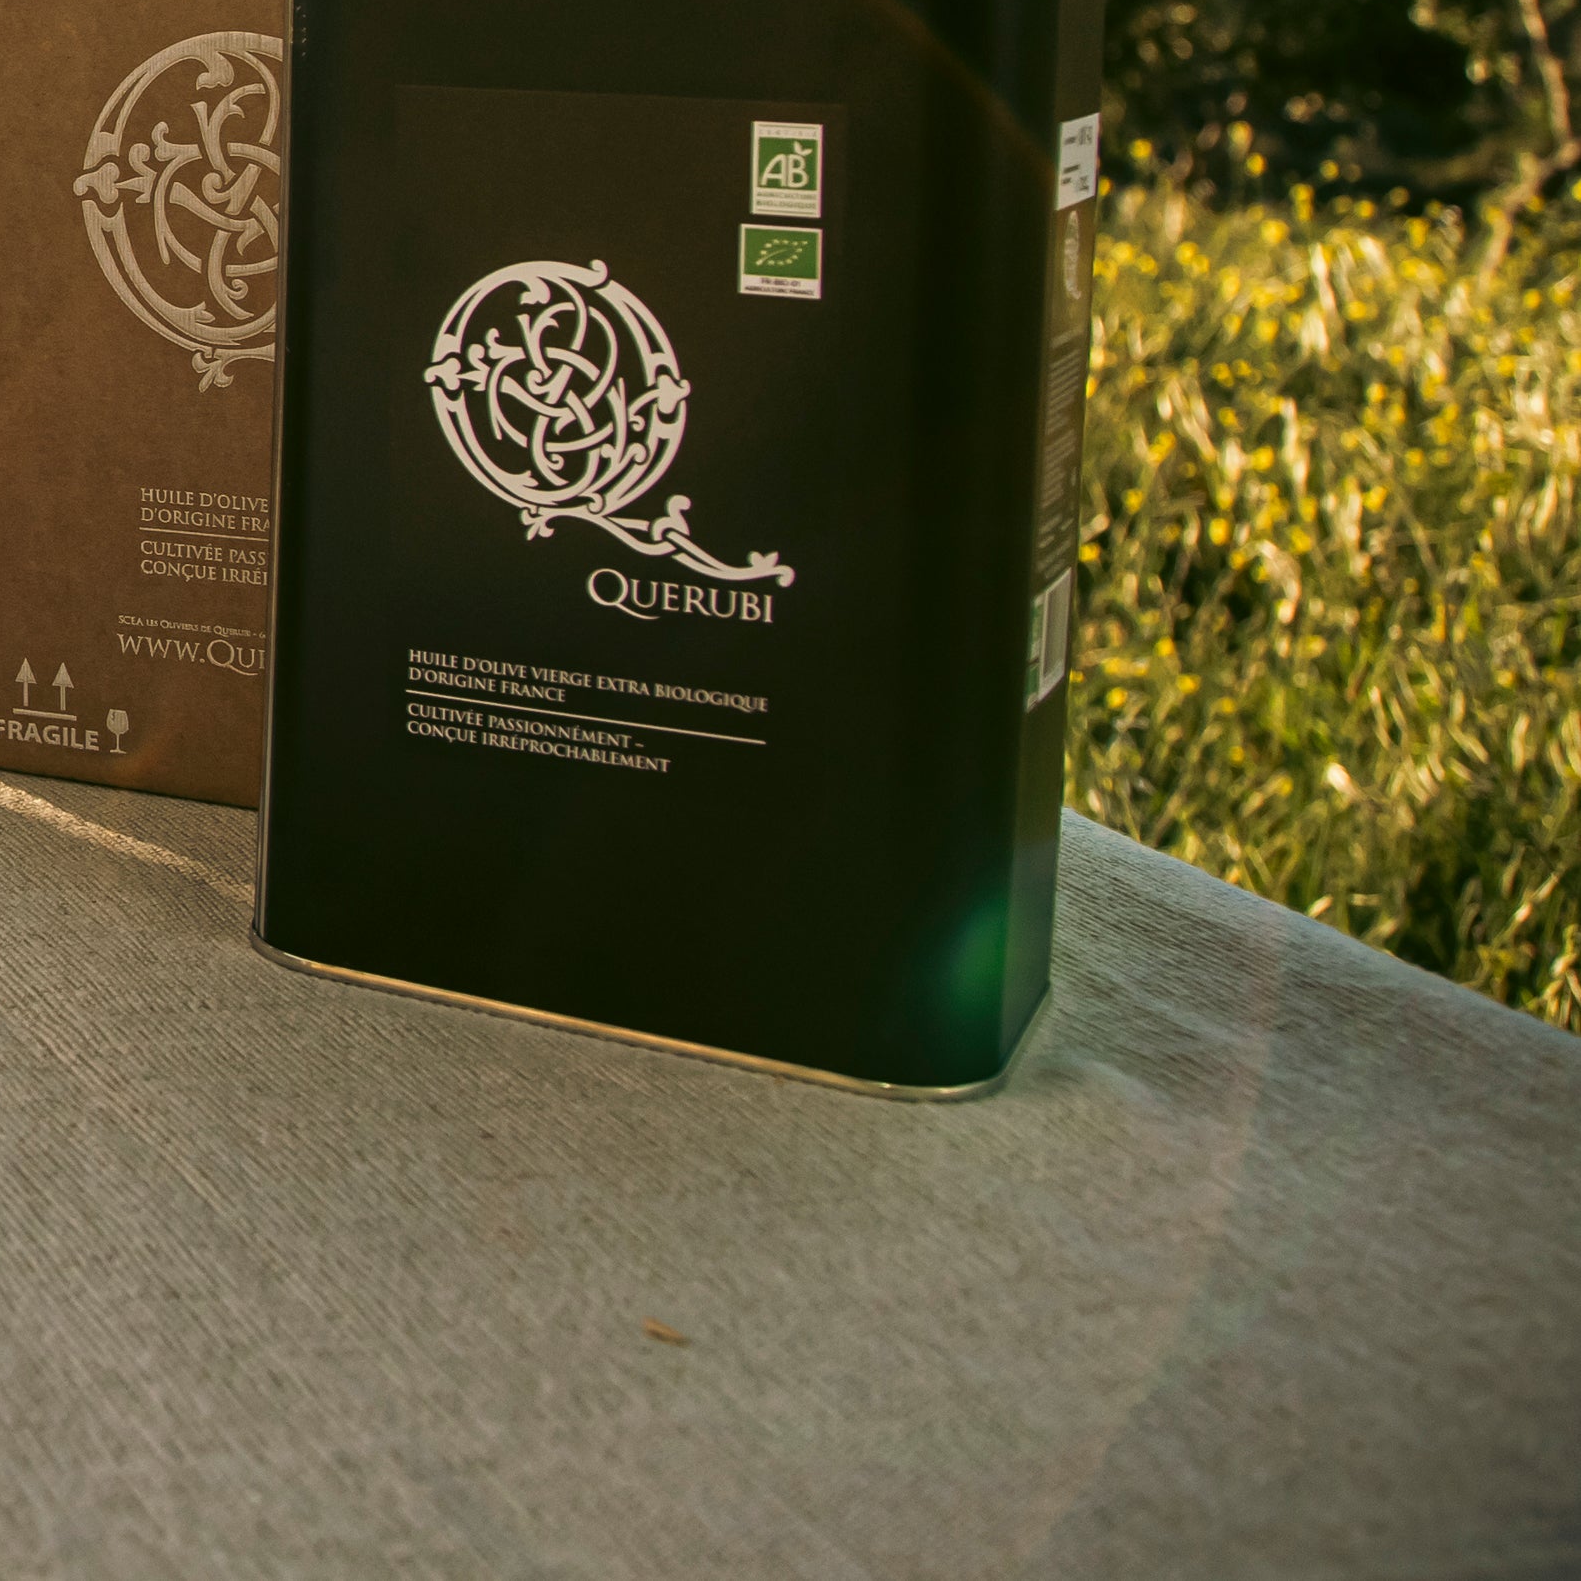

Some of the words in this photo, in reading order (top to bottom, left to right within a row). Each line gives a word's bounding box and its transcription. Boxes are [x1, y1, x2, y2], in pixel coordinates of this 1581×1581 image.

[760, 153, 809, 188] AB
[140, 487, 194, 507] HUILE
[199, 492, 269, 513] D'OLIVE
[140, 507, 235, 531] D'ORIGINE
[140, 540, 223, 563] CULTIVÉE
[140, 559, 216, 582] CONÇUE
[586, 568, 773, 623] QUERUBI
[118, 614, 144, 628] SCEA
[408, 648, 458, 670] HUILE
[462, 656, 527, 679] D'OLIVE
[531, 666, 592, 688] VIERGE
[597, 675, 650, 697] EXTRA
[653, 682, 769, 713] BIOLOGIQUE
[408, 666, 497, 692] D'ORIGINE
[501, 680, 566, 703] FRANCE
[407, 702, 484, 727] CULTIVÉE
[489, 714, 632, 749] PASSIONNÉMENT
[407, 720, 478, 744] CONÇUE
[482, 731, 671, 773] IRRÉPROCHABLEMENT
